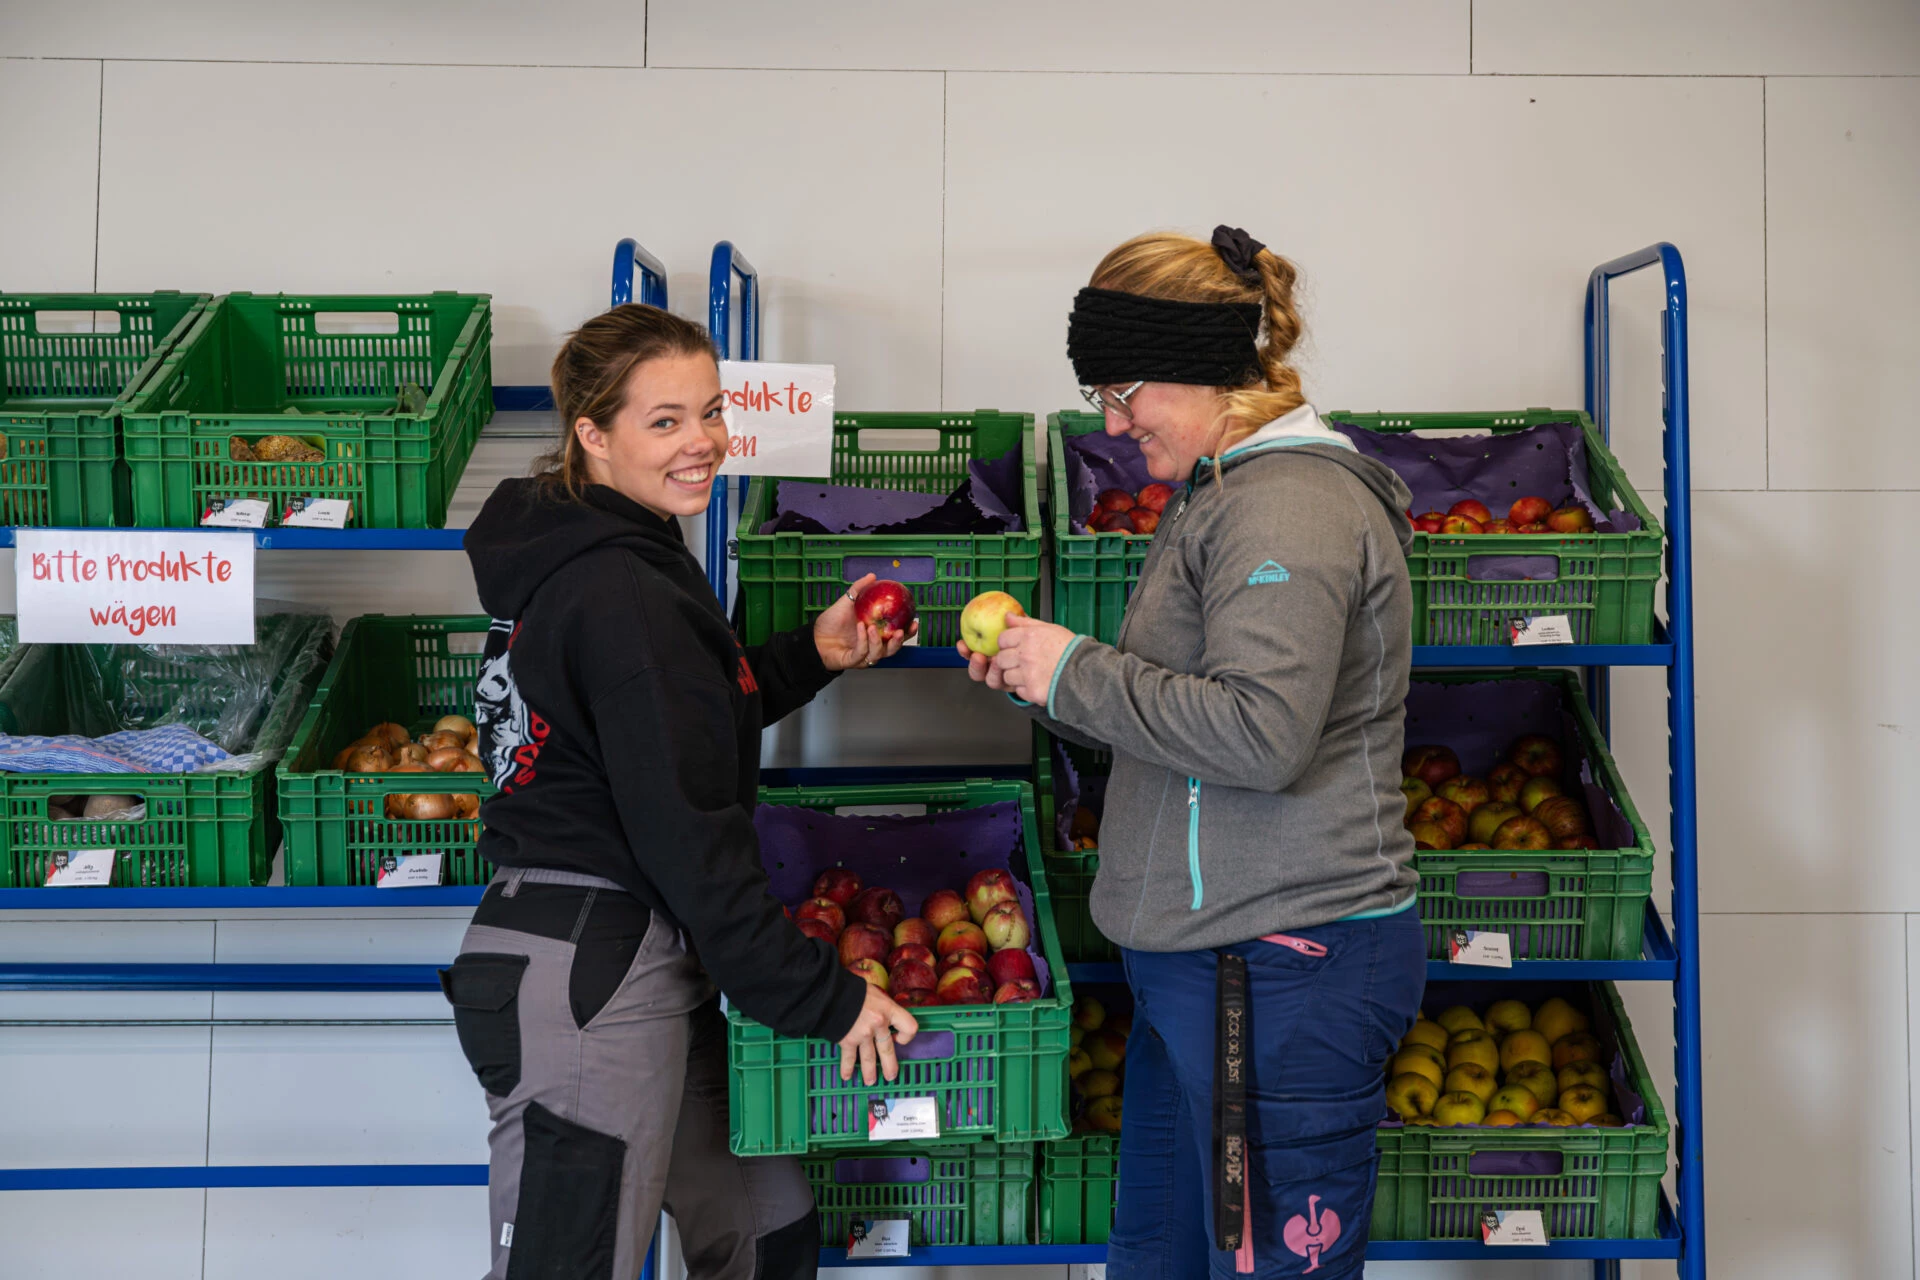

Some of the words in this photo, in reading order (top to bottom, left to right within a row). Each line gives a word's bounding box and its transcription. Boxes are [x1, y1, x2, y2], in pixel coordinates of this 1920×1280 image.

[721, 380, 812, 414] odukte
[726, 435, 757, 458] en
[32, 550, 97, 583] Bitte
[107, 550, 232, 584] Produkte
[89, 600, 177, 637] wägen
